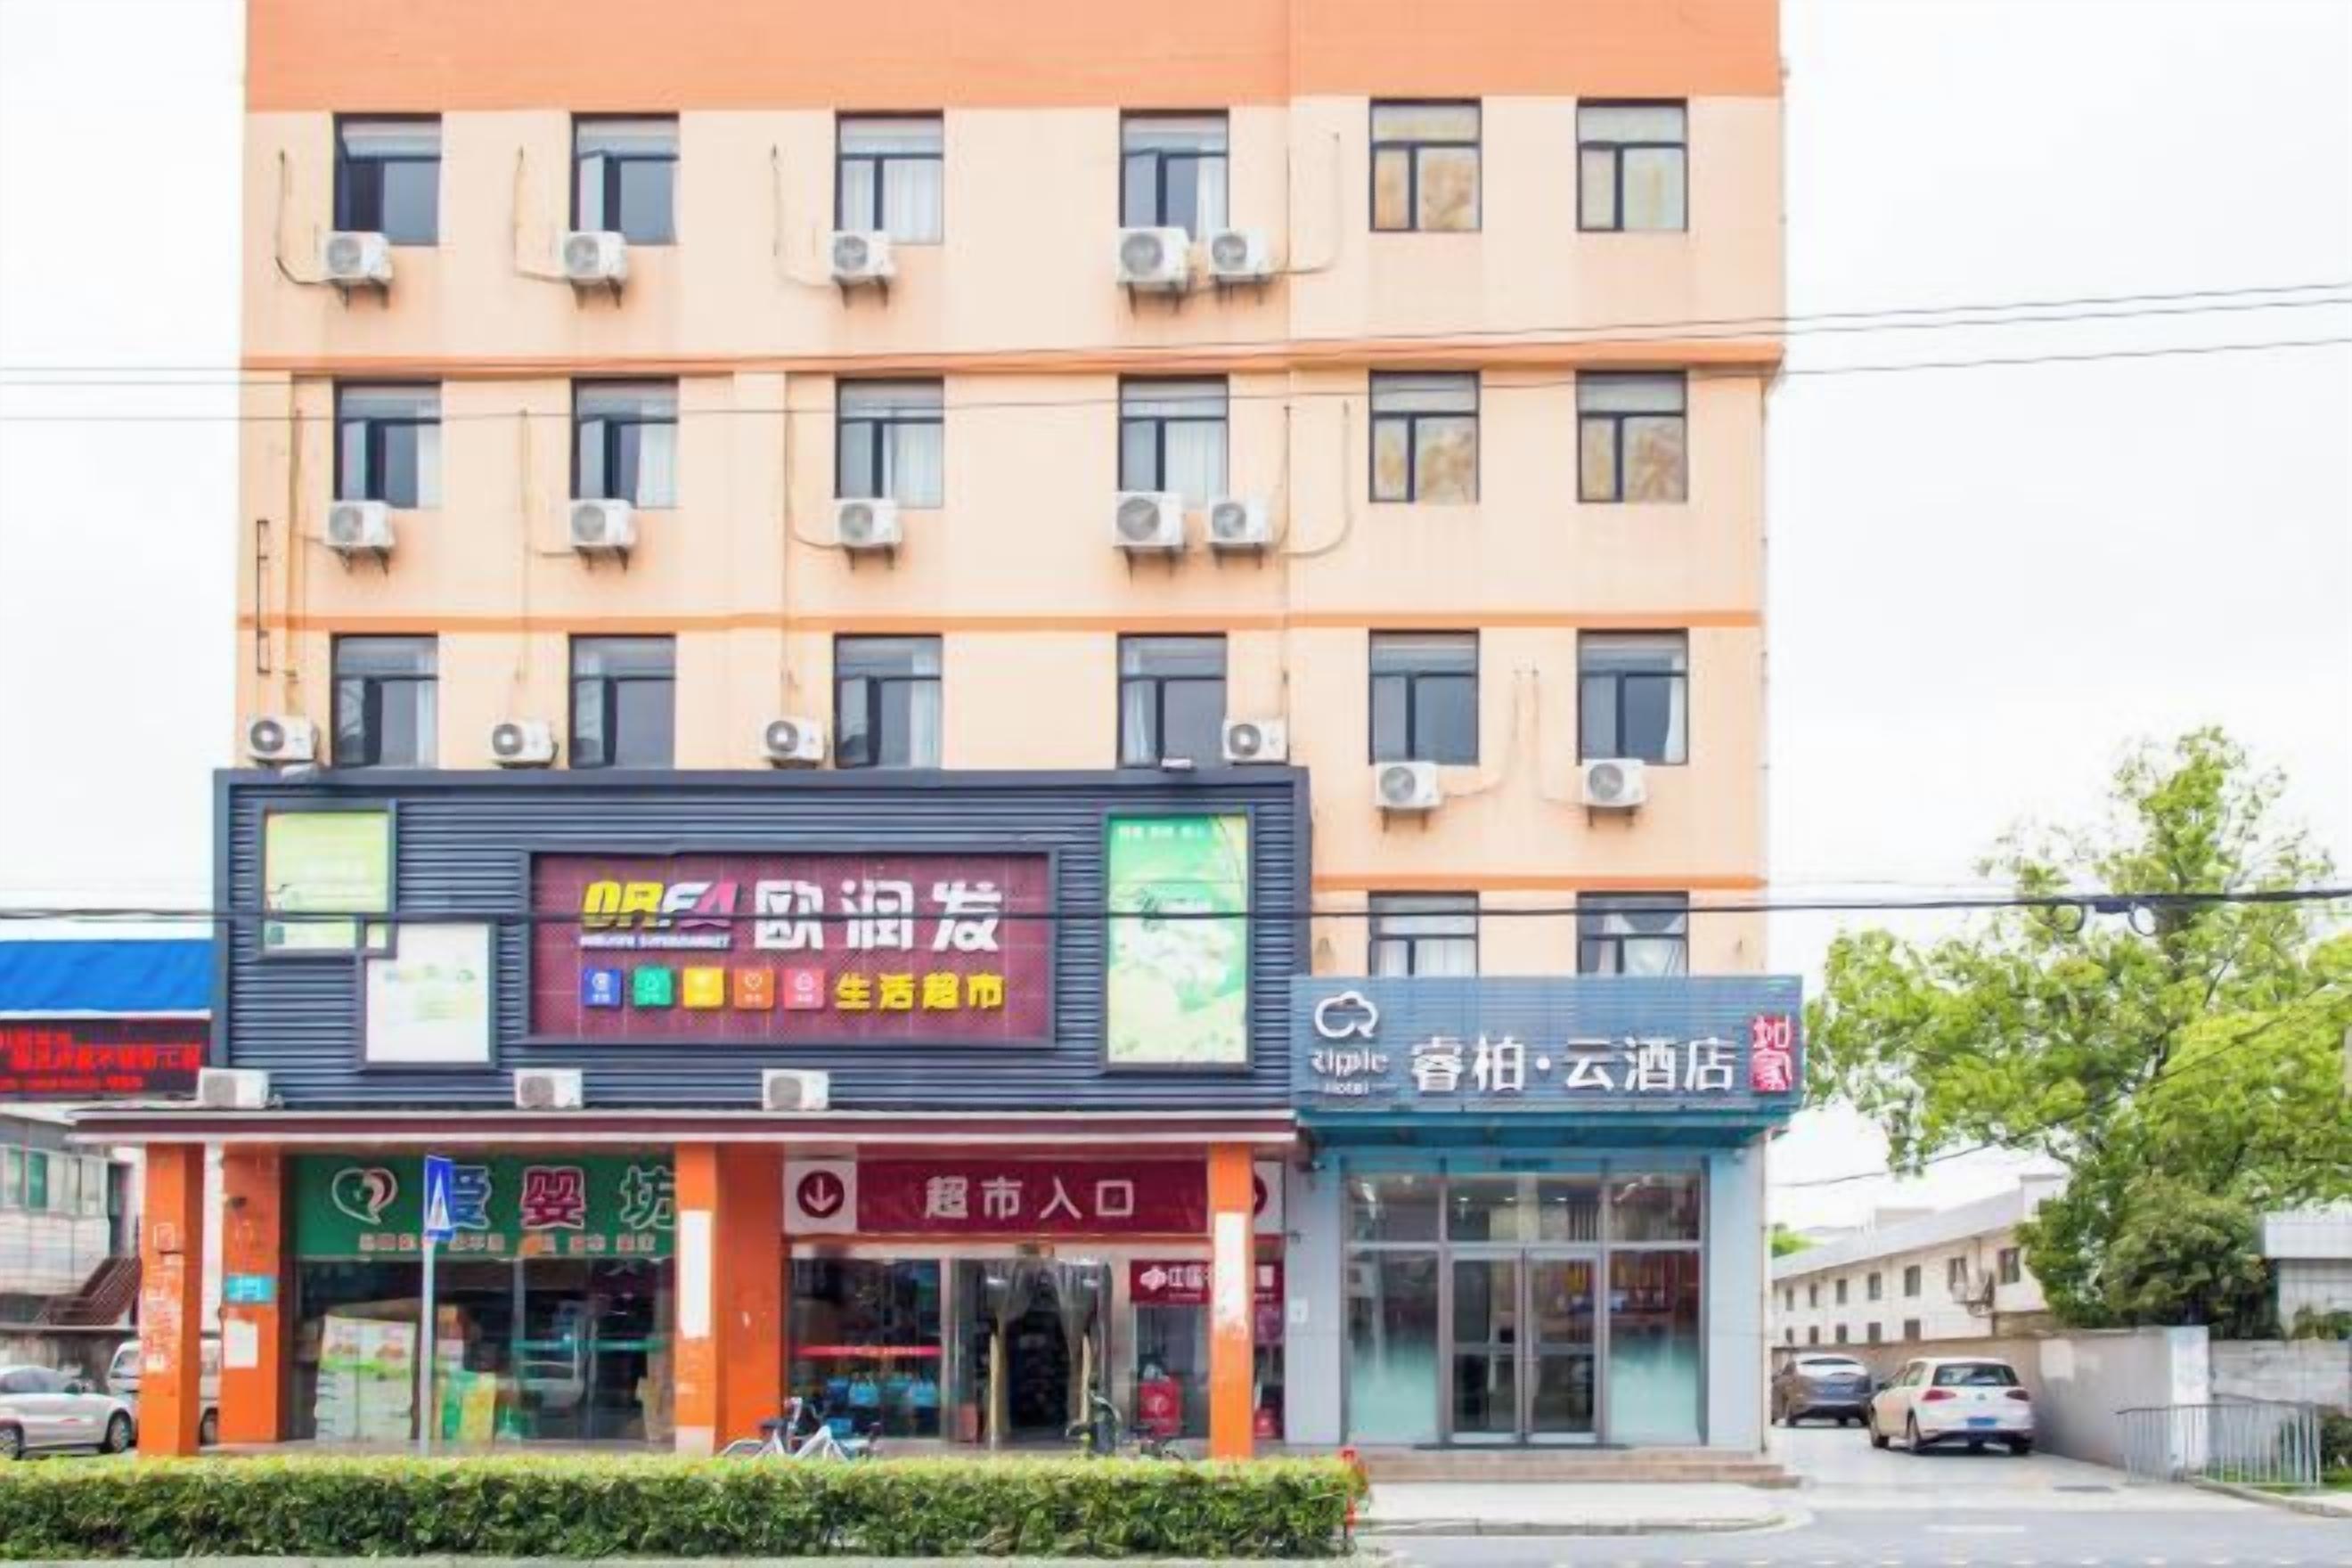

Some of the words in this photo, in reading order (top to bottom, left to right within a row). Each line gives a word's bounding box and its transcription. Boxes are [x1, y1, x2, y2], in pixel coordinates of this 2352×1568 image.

[754, 879, 1003, 951] 欧润发
[834, 972, 1005, 1009] 生活超市
[1410, 1035, 1737, 1092] 睿柏·云酒店
[926, 1176, 1135, 1220] 超市入口
